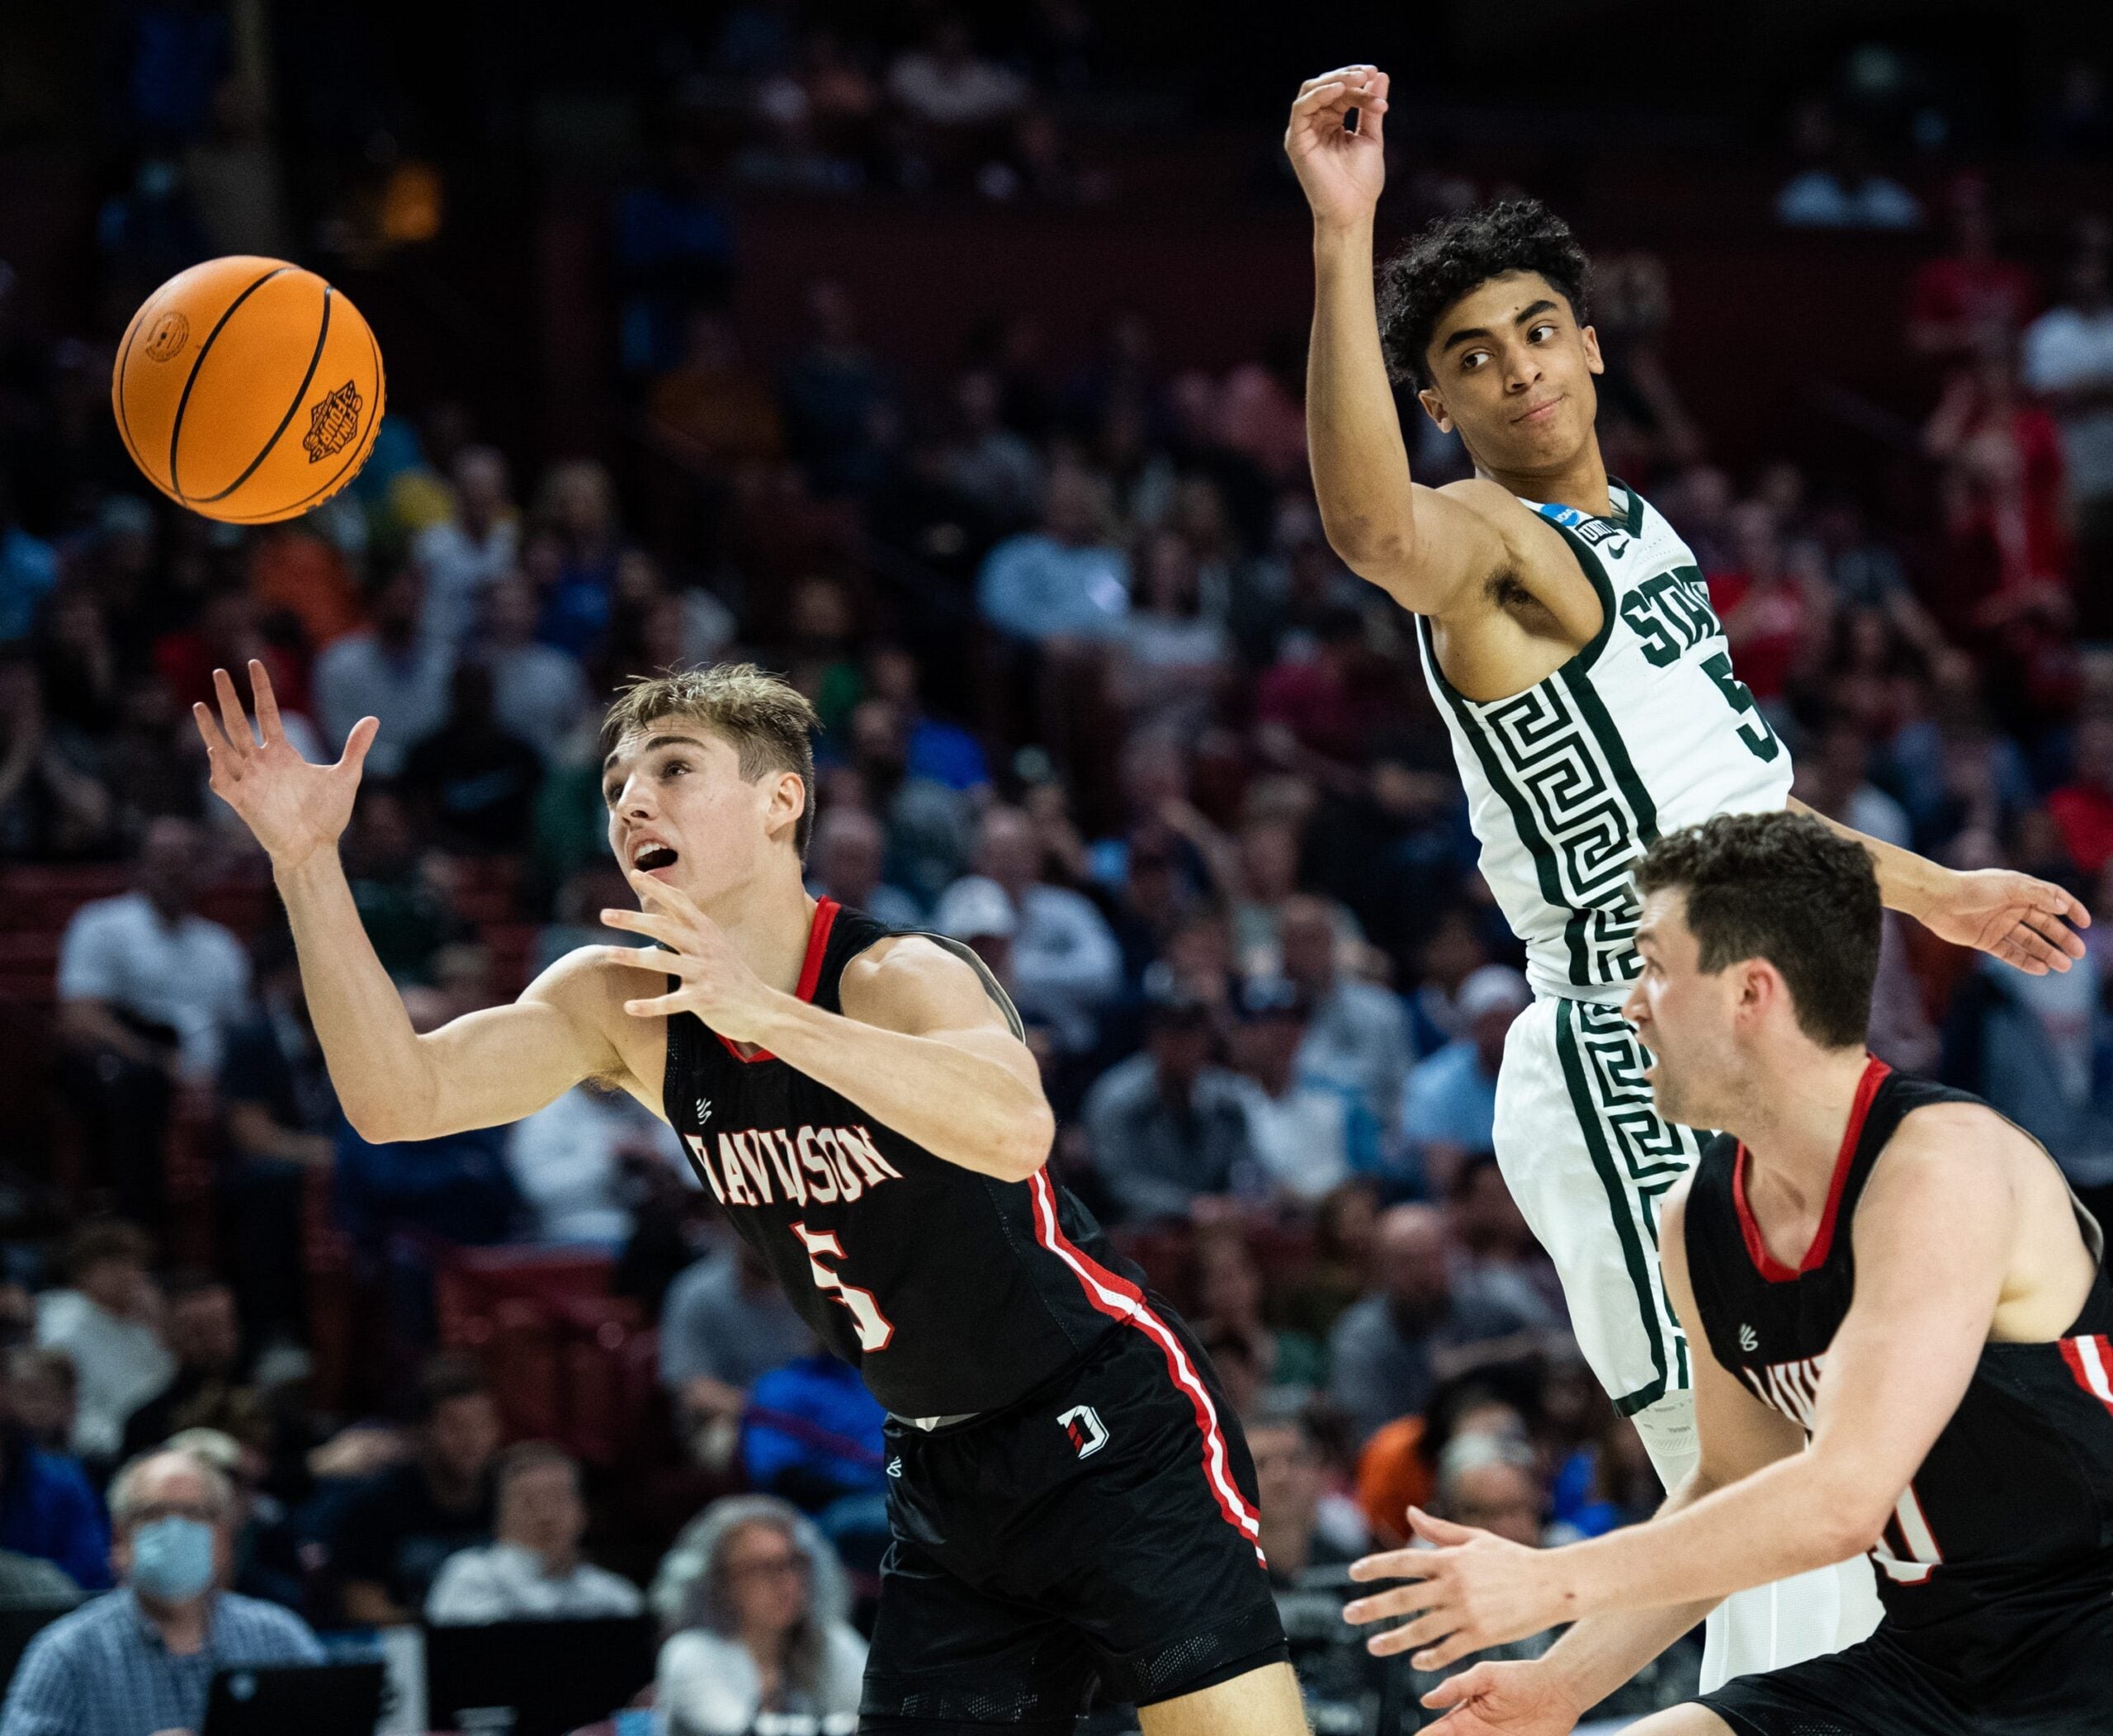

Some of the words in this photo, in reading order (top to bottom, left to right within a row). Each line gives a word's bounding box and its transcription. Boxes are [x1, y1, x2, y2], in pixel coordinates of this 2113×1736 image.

[319, 398, 347, 447] FOUR
[332, 408, 357, 454] FINAL
[1699, 650, 1780, 763] 5
[789, 1220, 896, 1352] 5
